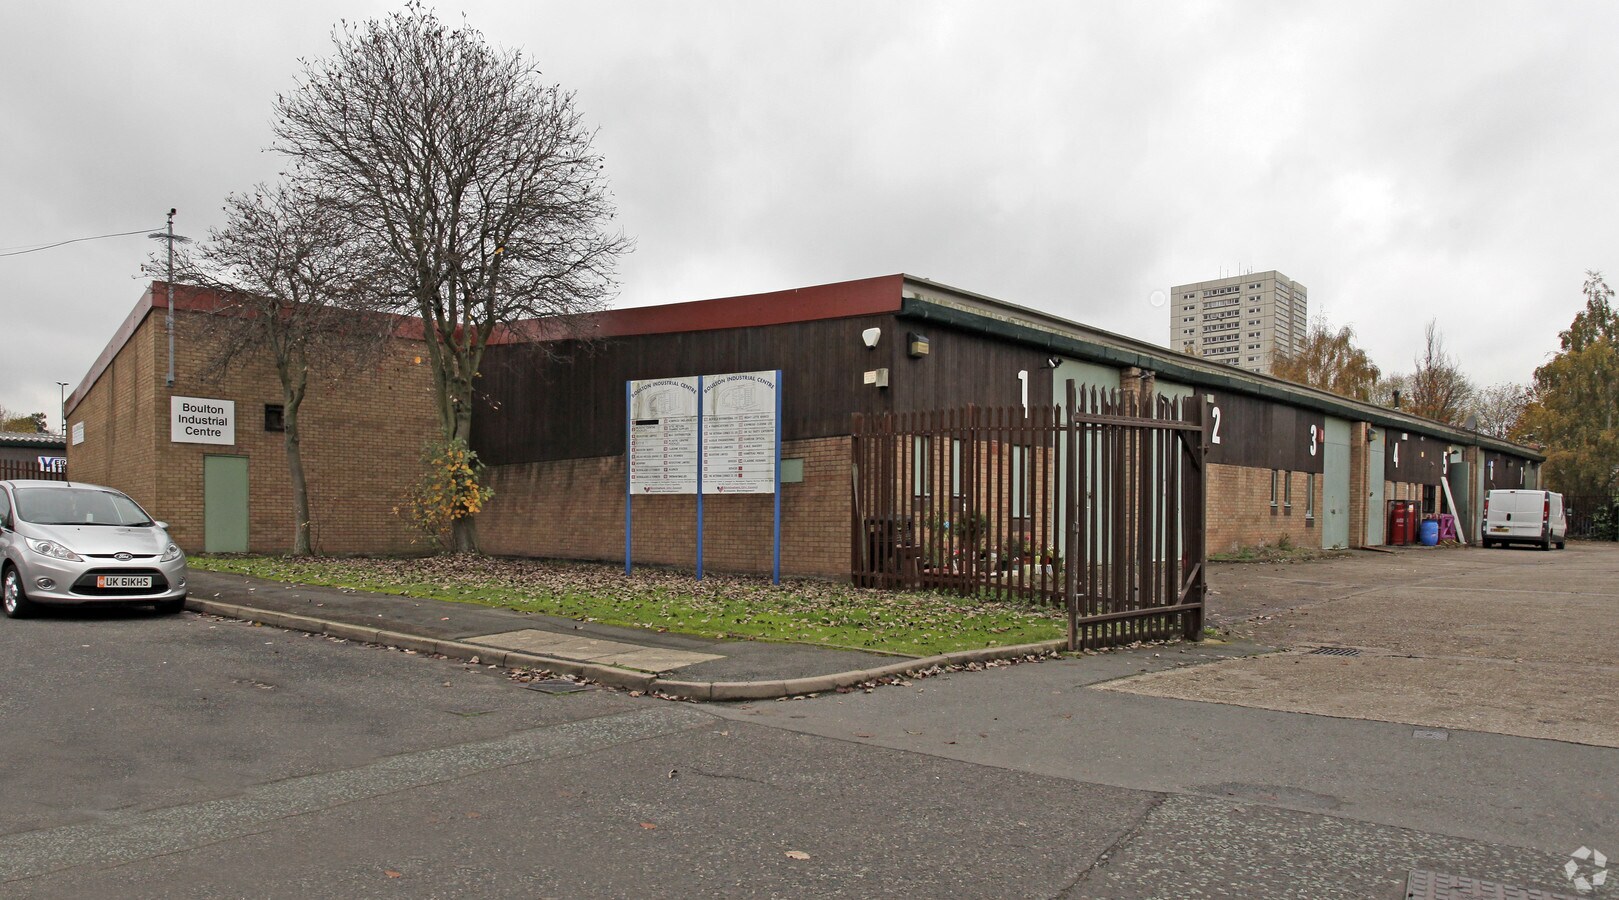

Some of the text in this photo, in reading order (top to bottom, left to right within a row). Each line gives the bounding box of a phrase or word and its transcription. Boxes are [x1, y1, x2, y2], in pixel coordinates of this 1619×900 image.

[631, 383, 652, 399] BOULTON
[680, 382, 697, 395] CENTRE
[703, 378, 726, 394] BOULTON
[757, 377, 775, 390] CENTRE
[1017, 370, 1029, 419] 1
[182, 402, 224, 415] Boulton
[178, 414, 228, 426] Industrial
[1211, 406, 1221, 444] 2
[185, 426, 221, 437] Centre
[1310, 424, 1318, 456] 3
[1393, 442, 1399, 468] 4
[1443, 451, 1448, 475] 5
[106, 577, 119, 587] UK
